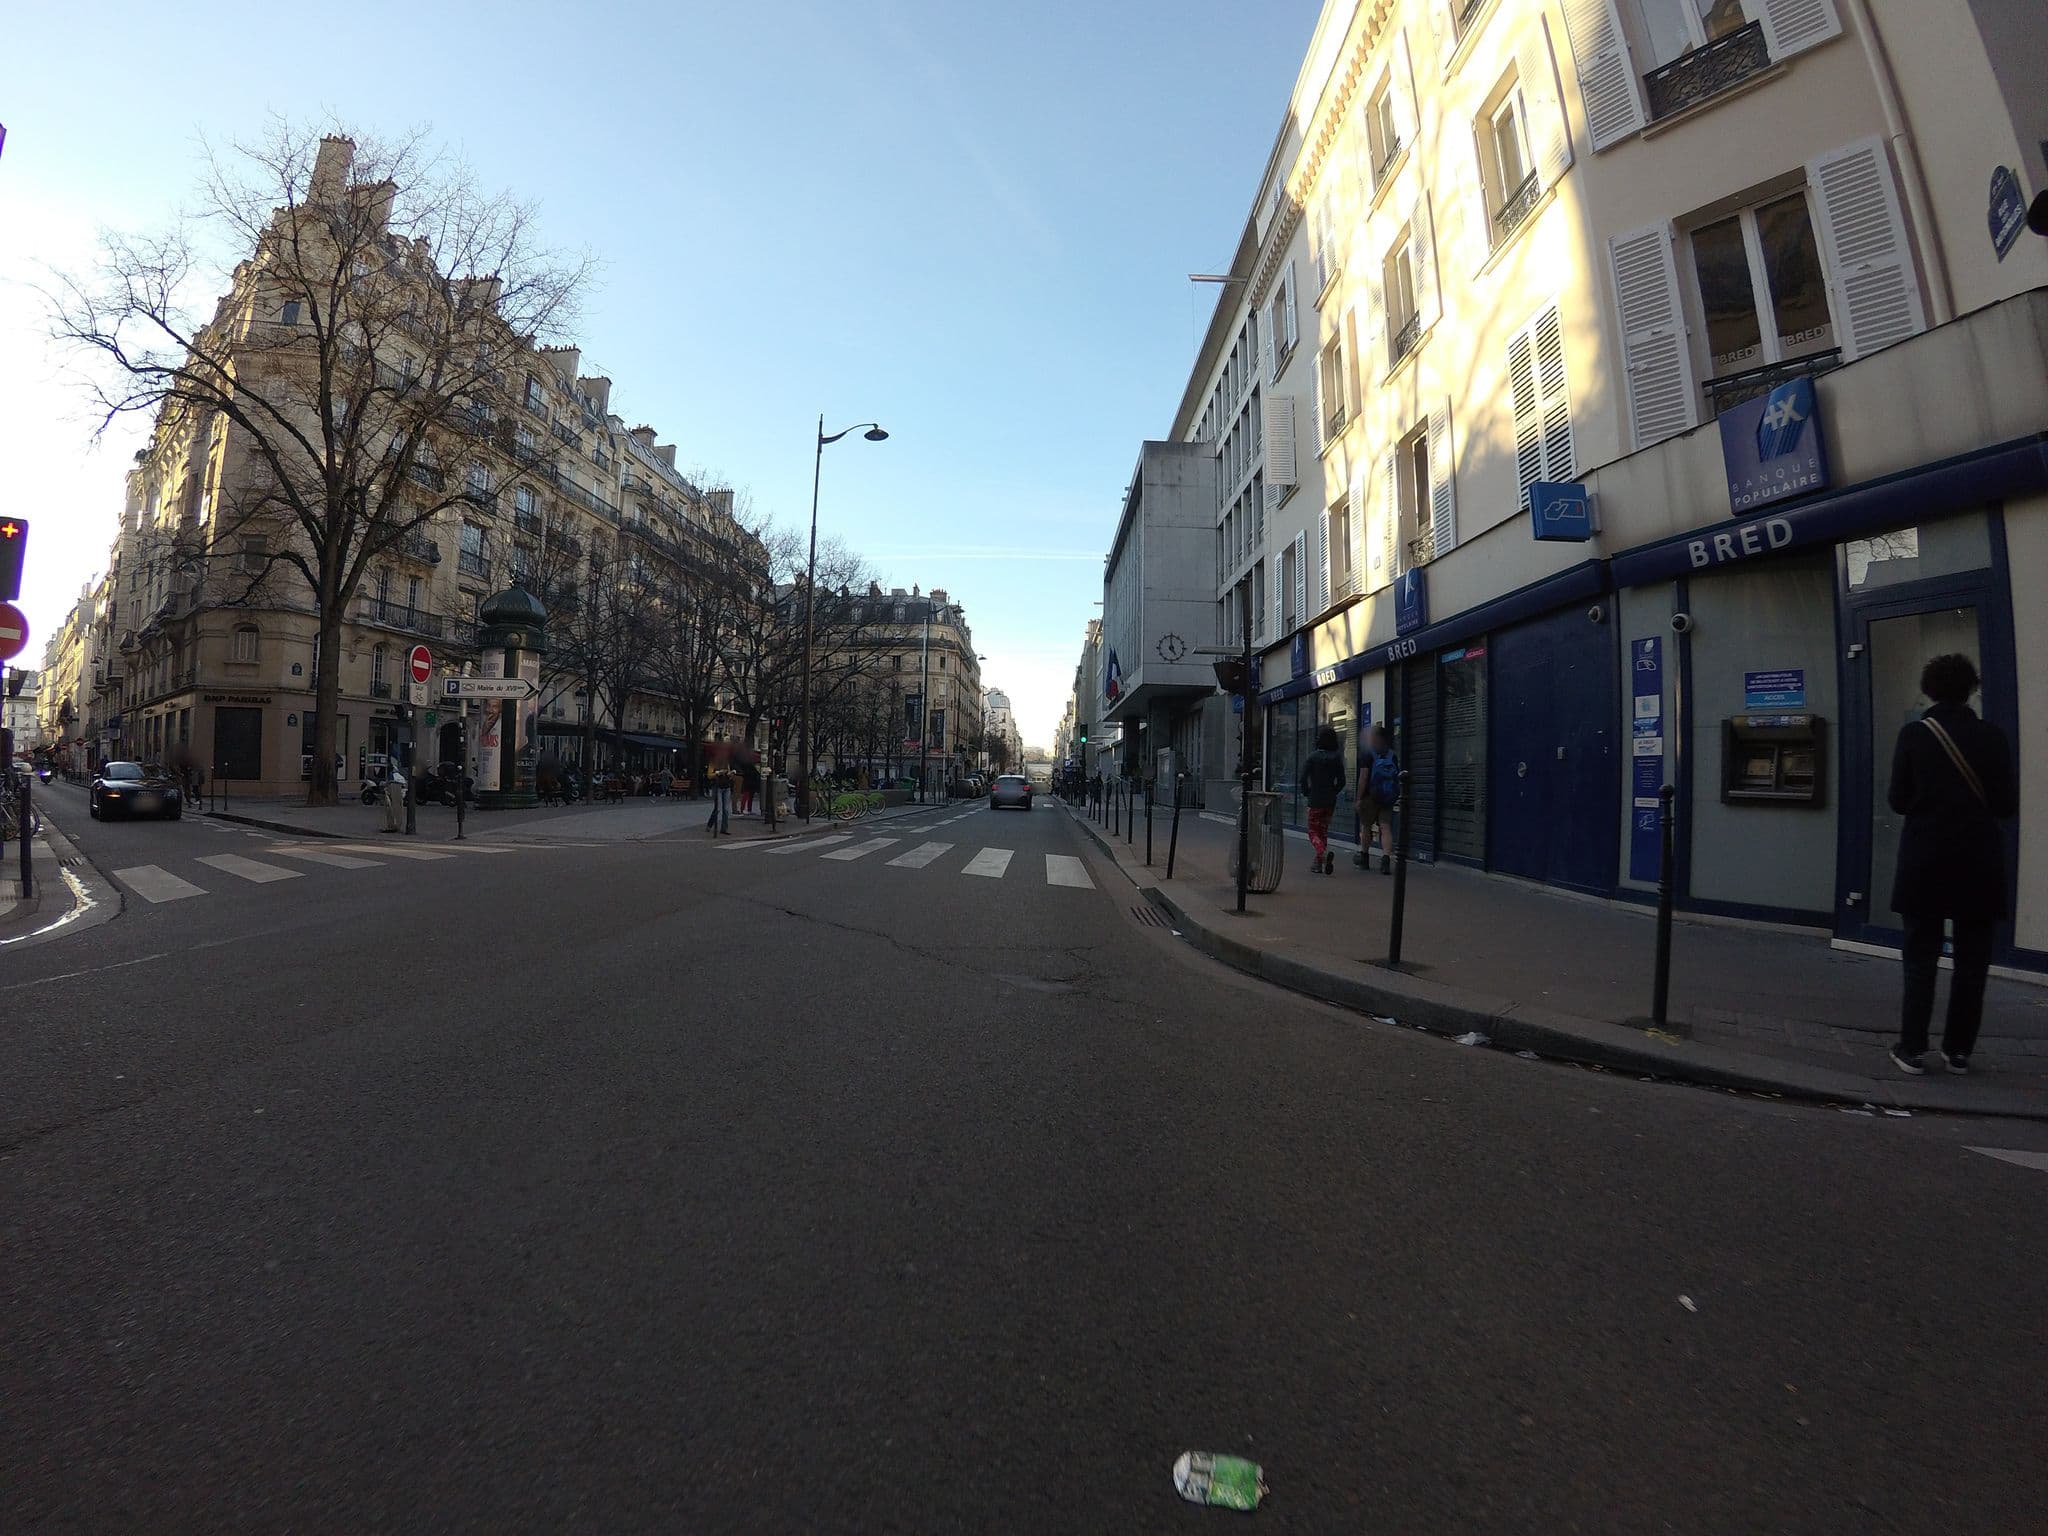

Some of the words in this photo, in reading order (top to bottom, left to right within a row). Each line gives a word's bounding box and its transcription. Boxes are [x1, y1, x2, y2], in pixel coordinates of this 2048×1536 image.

[1785, 326, 1826, 346] BRED
[1718, 347, 1756, 365] BRED
[1732, 457, 1818, 493] BANQUE
[1734, 473, 1818, 506] POPULAIRE
[1688, 518, 1794, 568] BRED
[1387, 639, 1417, 662] BRED
[1316, 669, 1336, 687] BRED
[203, 694, 226, 703] BNP
[228, 694, 272, 705] PARIBAS
